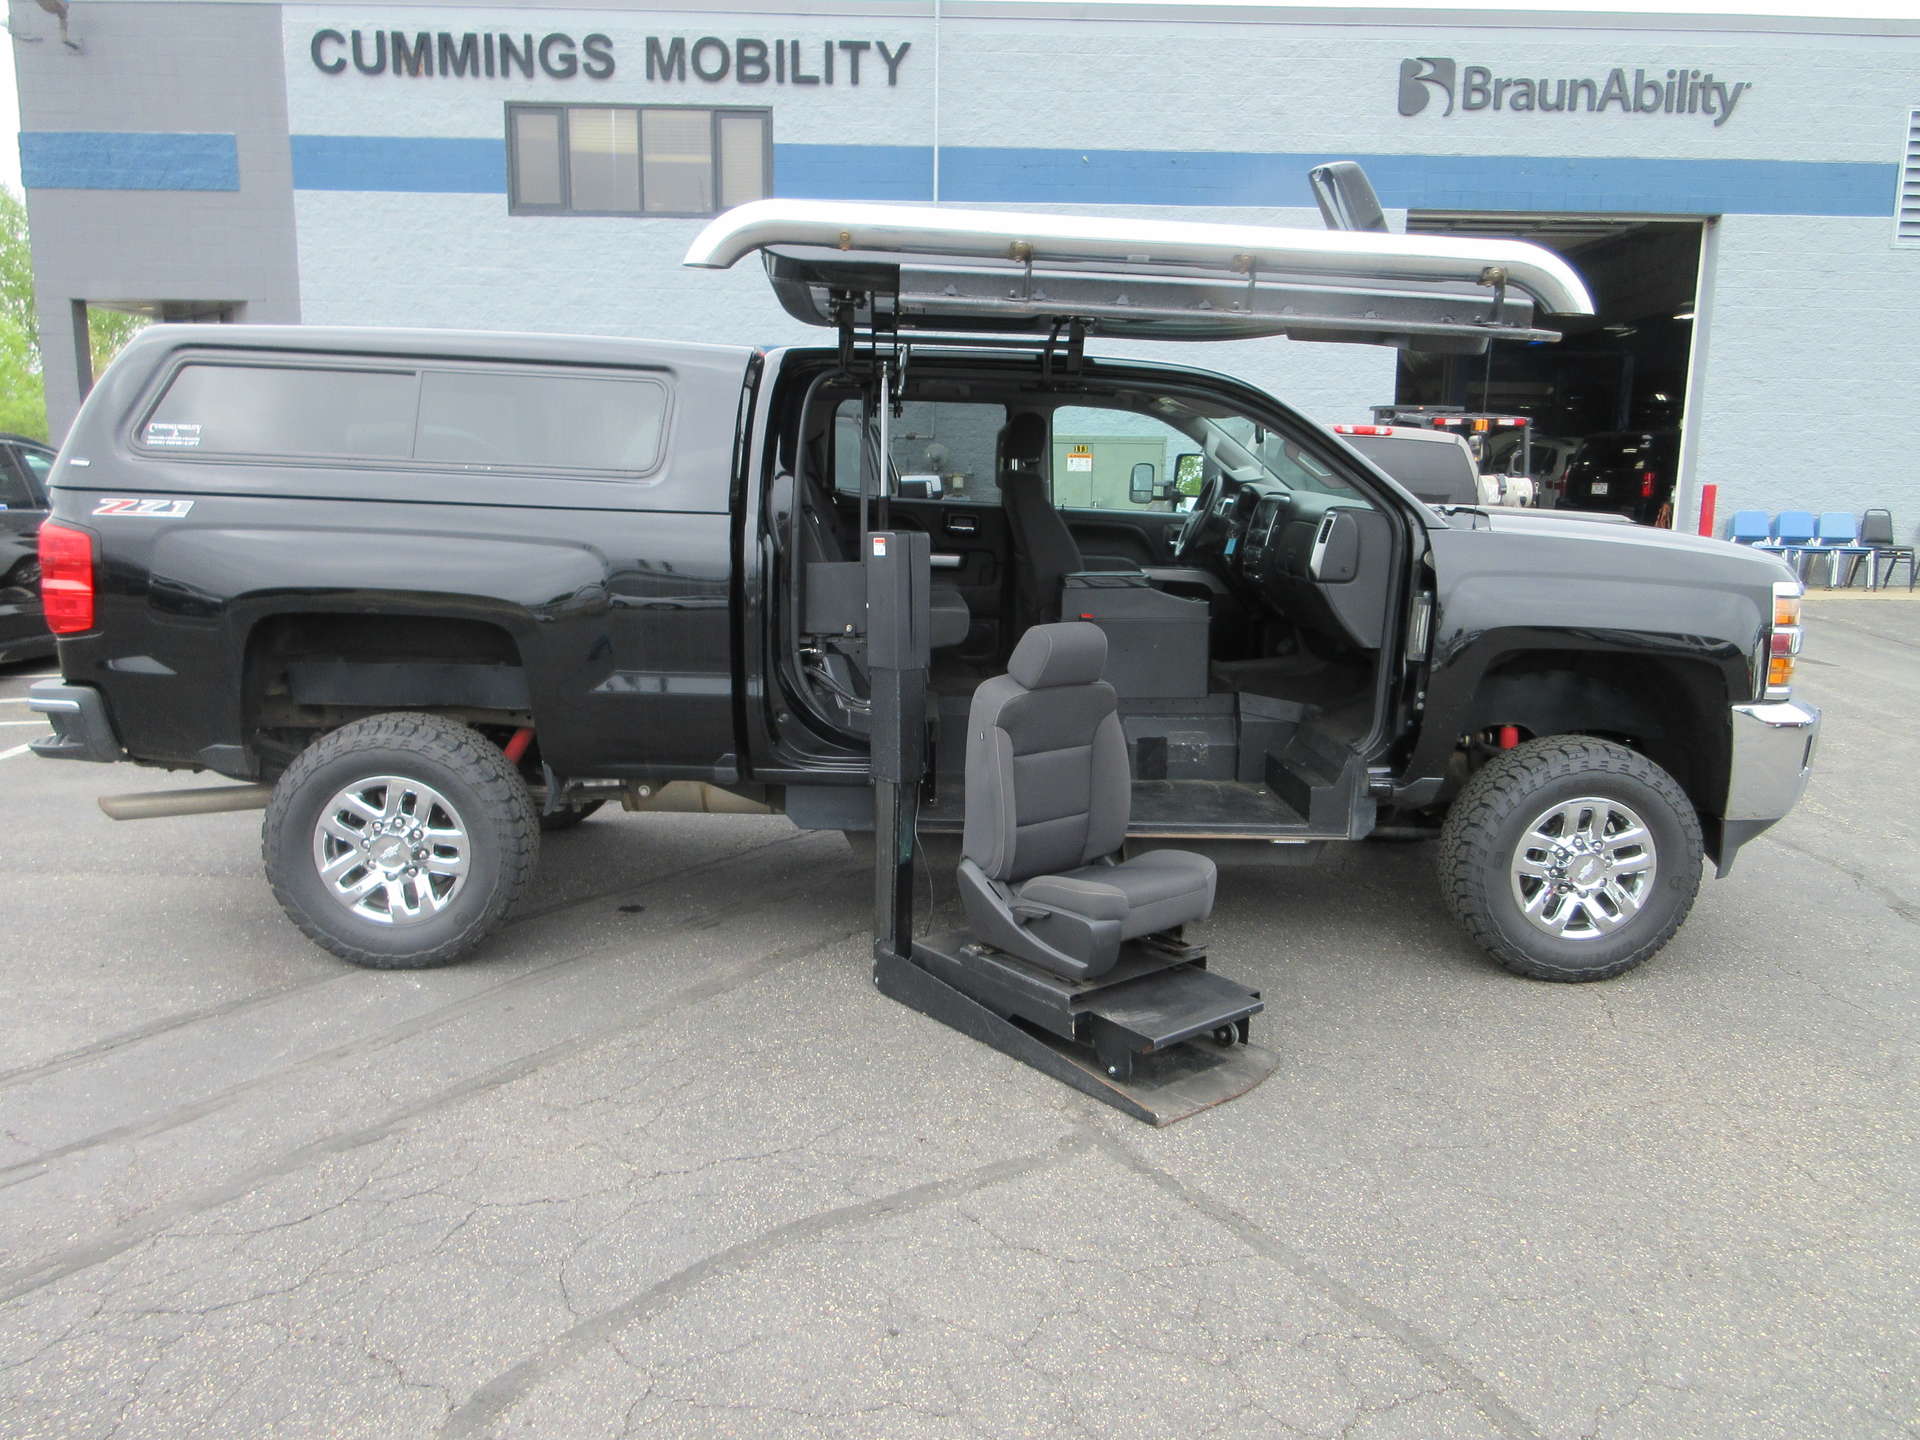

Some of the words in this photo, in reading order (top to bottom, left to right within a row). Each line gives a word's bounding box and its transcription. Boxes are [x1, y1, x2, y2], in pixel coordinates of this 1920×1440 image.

[310, 28, 616, 79] CUMMINGS
[645, 36, 911, 86] MOBILITY
[1461, 65, 1747, 128] BraunAbility
[92, 498, 195, 518] Z71
